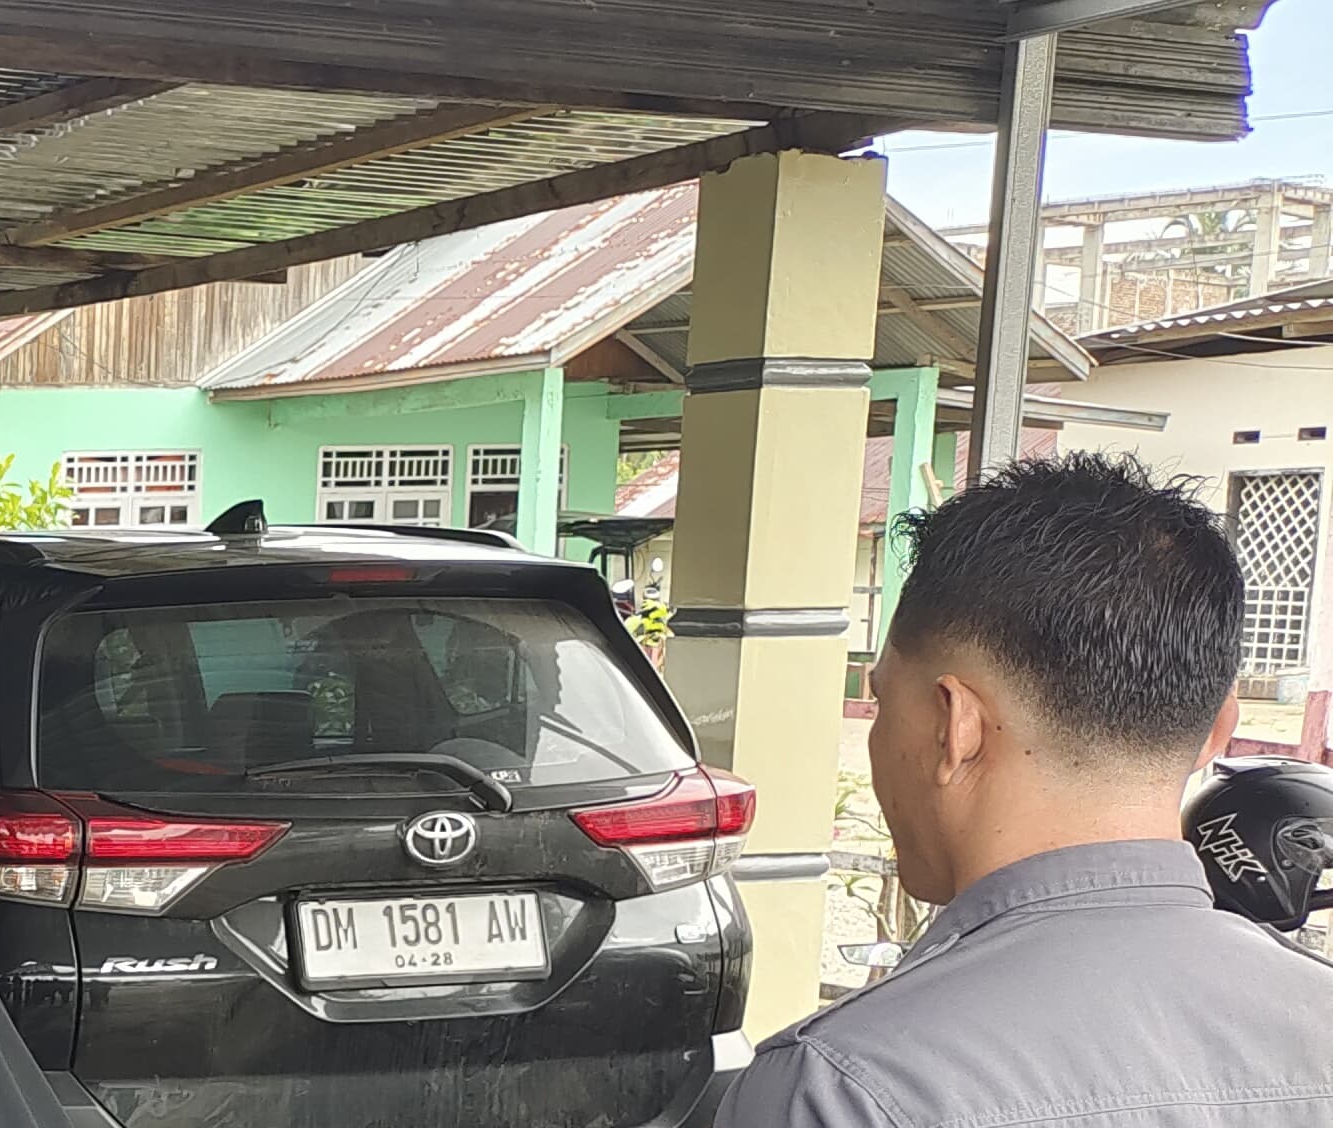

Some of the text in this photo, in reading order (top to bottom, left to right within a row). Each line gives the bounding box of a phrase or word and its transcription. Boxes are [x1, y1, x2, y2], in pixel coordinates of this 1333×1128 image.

[1197, 813, 1268, 882] NHK
[311, 898, 528, 951] DM 1581 AW
[100, 953, 218, 974] Rush
